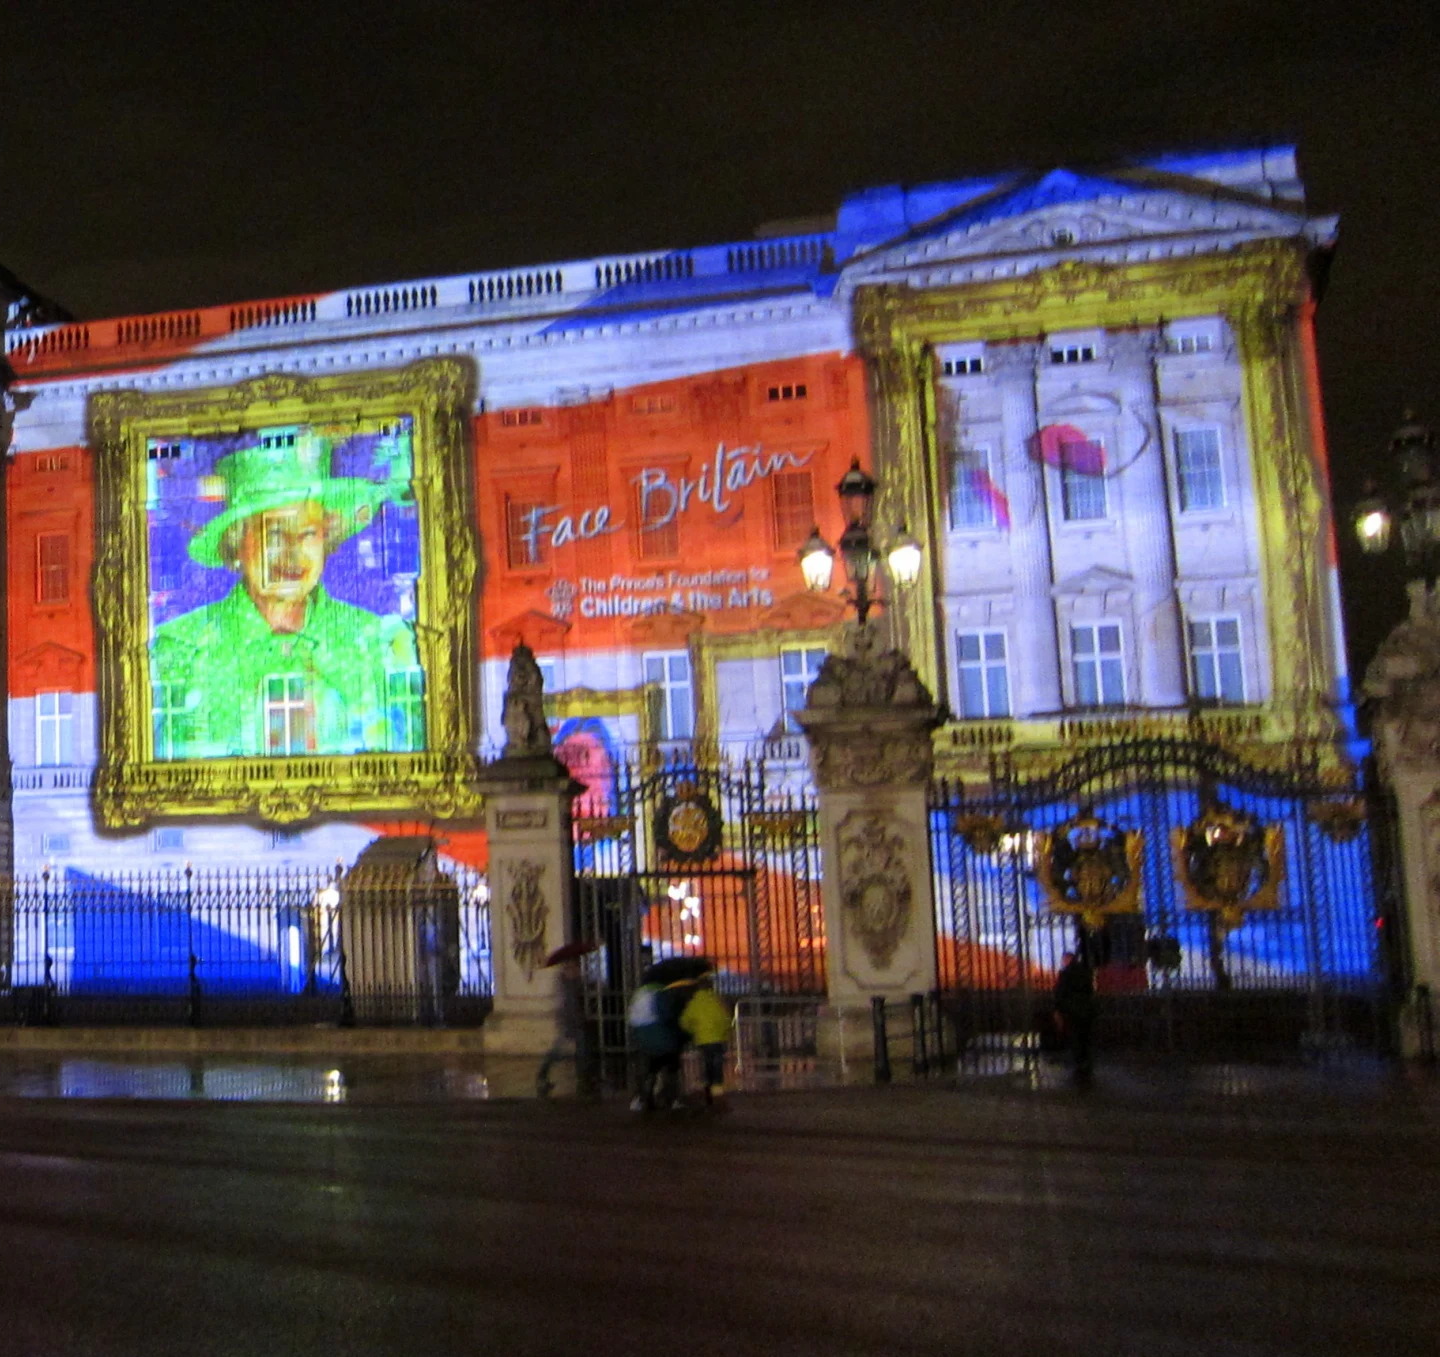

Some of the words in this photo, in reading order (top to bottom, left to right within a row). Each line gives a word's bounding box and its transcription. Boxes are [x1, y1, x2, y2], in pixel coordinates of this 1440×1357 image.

[521, 503, 625, 562] Face
[630, 441, 814, 532] Britain
[580, 575, 607, 594] The
[669, 567, 748, 590] Foundation
[749, 565, 772, 582] for
[580, 595, 665, 617] Children
[668, 590, 684, 614] &
[688, 589, 723, 612] the
[727, 586, 774, 609] Arts
